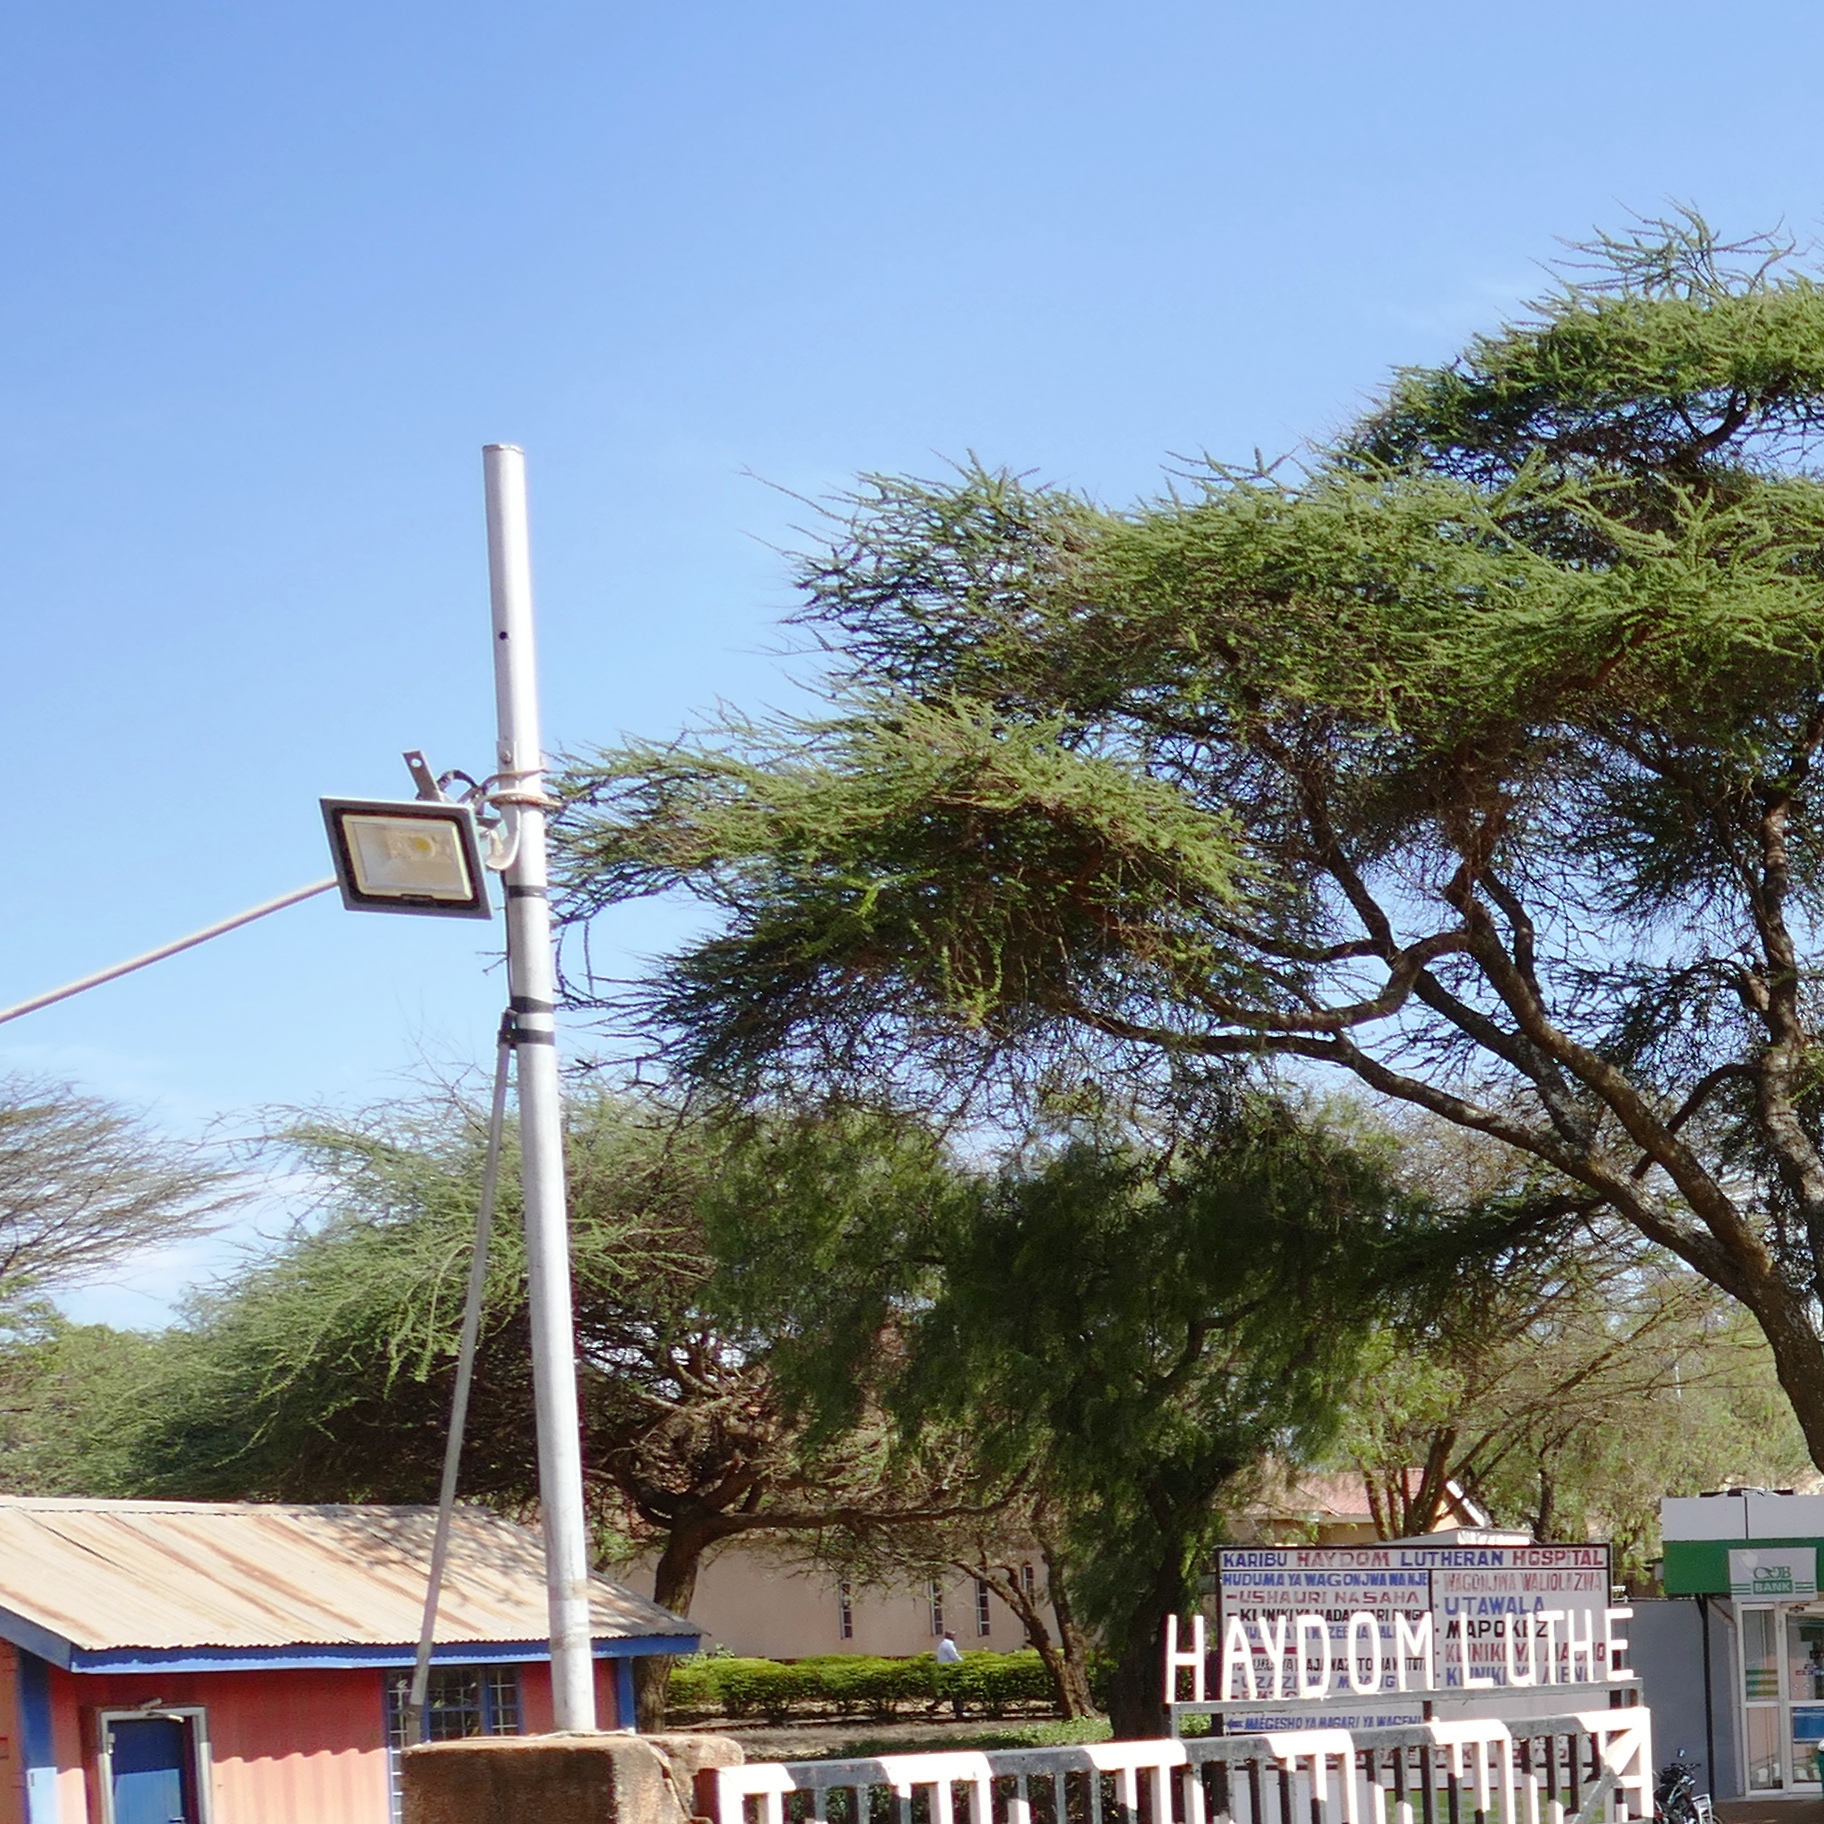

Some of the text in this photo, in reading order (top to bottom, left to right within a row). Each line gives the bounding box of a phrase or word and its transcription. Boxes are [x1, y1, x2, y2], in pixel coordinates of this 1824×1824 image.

[1223, 1552, 1288, 1567] KARIBU
[1297, 1551, 1391, 1567] HAYDOM
[1401, 1551, 1504, 1567] LUTHERAN
[1222, 1573, 1283, 1587] HUDUMA
[1288, 1573, 1301, 1587] YA
[1304, 1573, 1387, 1587] WAGONJWA
[1408, 1573, 1428, 1586] NJE
[1755, 1581, 1791, 1592] BANK
[1444, 1596, 1545, 1615] UTAWALA
[1166, 1608, 1634, 1705] HAYDOM LUTHE
[1305, 1717, 1317, 1728] YA
